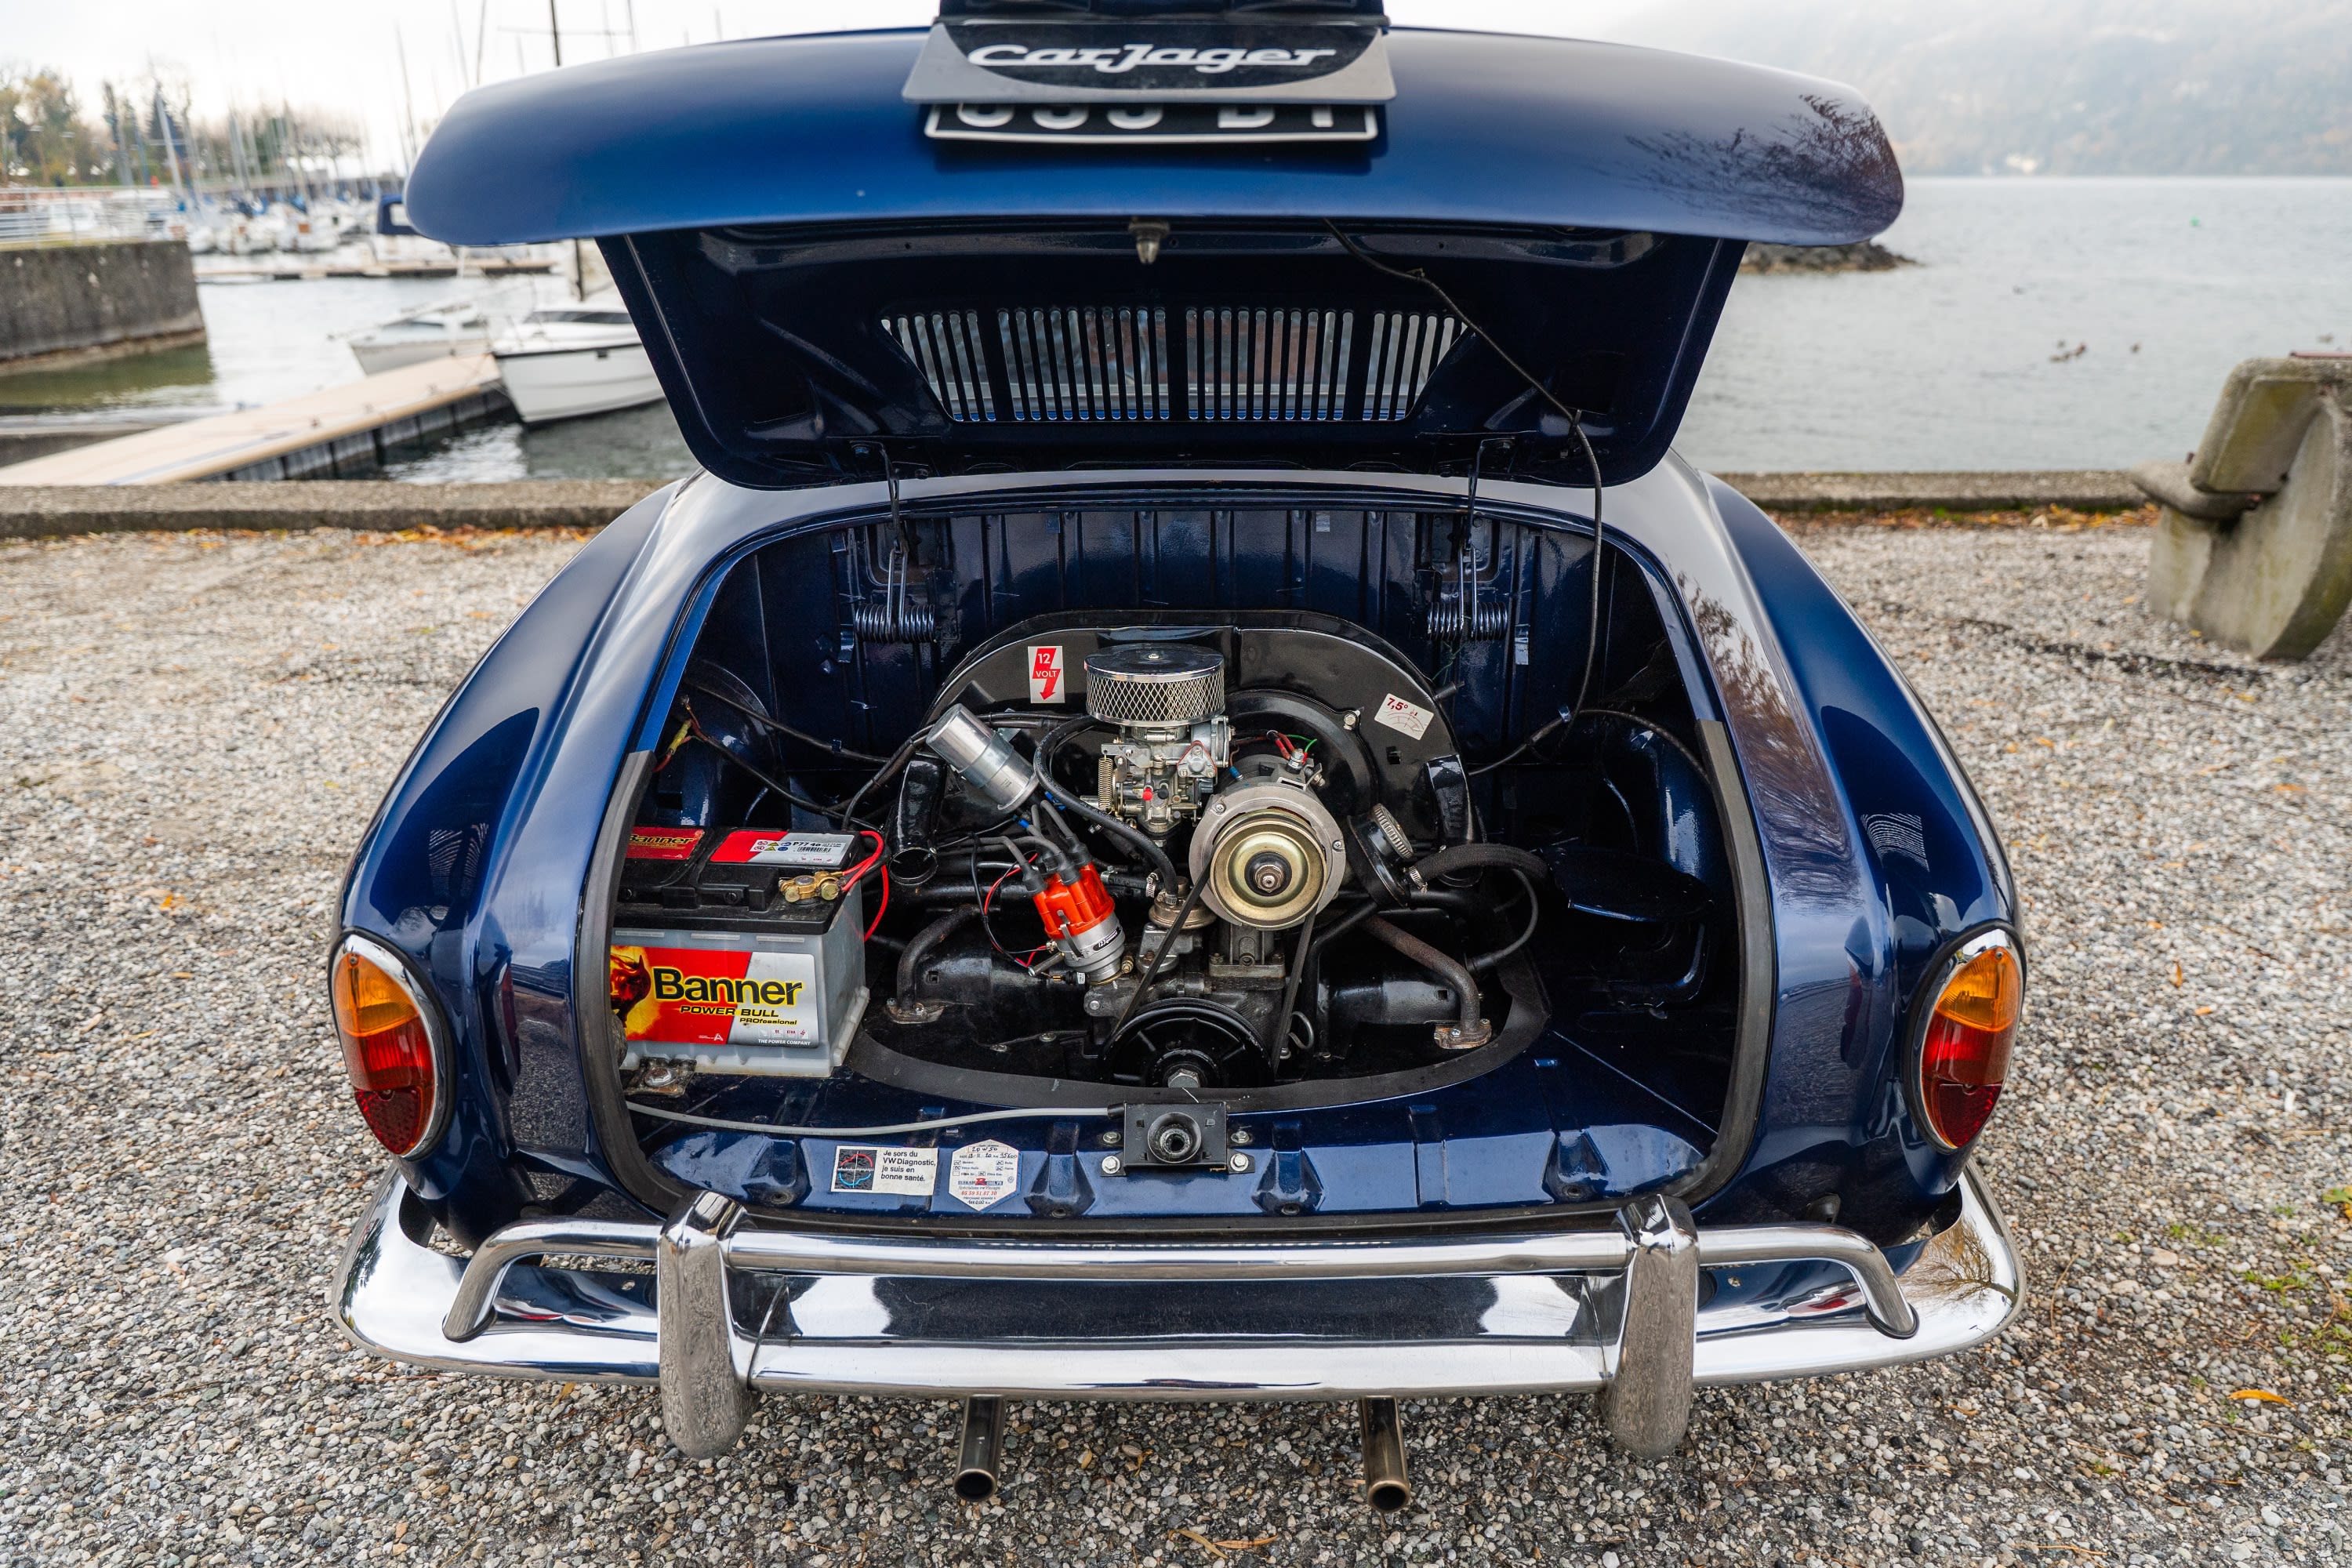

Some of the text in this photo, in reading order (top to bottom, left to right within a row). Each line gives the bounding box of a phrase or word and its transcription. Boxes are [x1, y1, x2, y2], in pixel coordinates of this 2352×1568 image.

[967, 44, 1336, 73] CarJager
[1037, 653, 1051, 664] 12
[1387, 697, 1408, 710] 7,5°
[652, 967, 803, 1005] Banner
[680, 1006, 779, 1018] POWER BULL
